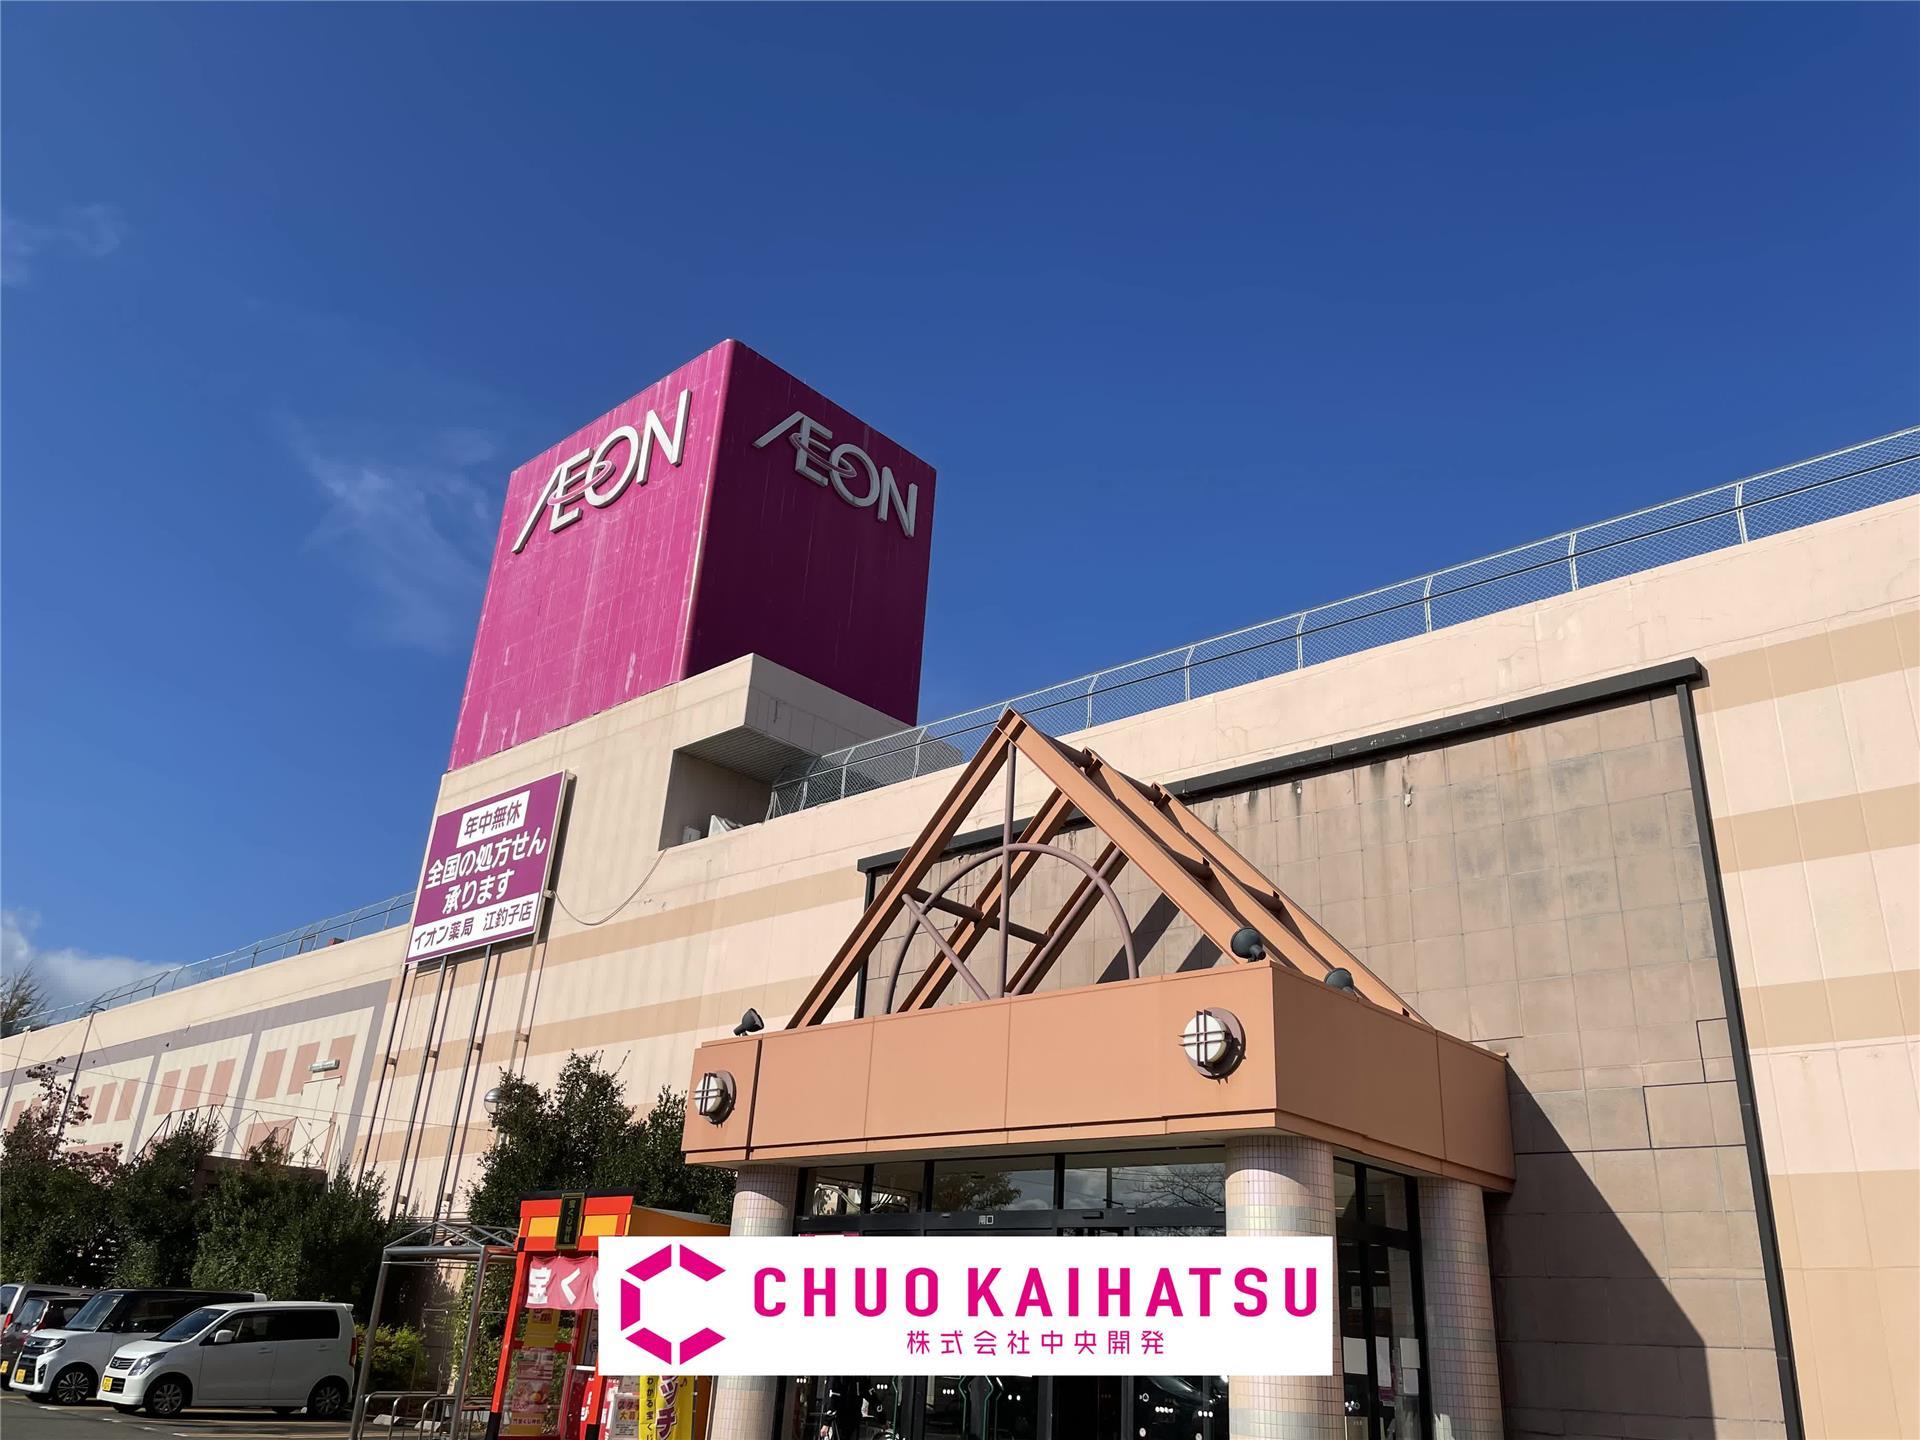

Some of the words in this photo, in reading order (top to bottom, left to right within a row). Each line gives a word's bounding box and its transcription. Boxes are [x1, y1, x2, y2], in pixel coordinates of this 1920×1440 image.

[464, 800, 522, 839] 年中無休
[425, 827, 547, 889] 全国の処方せん
[442, 869, 515, 914] 承ります
[414, 917, 474, 950] イオン薬局
[482, 900, 534, 931] 江釣子店
[527, 1266, 598, 1305] 宝く
